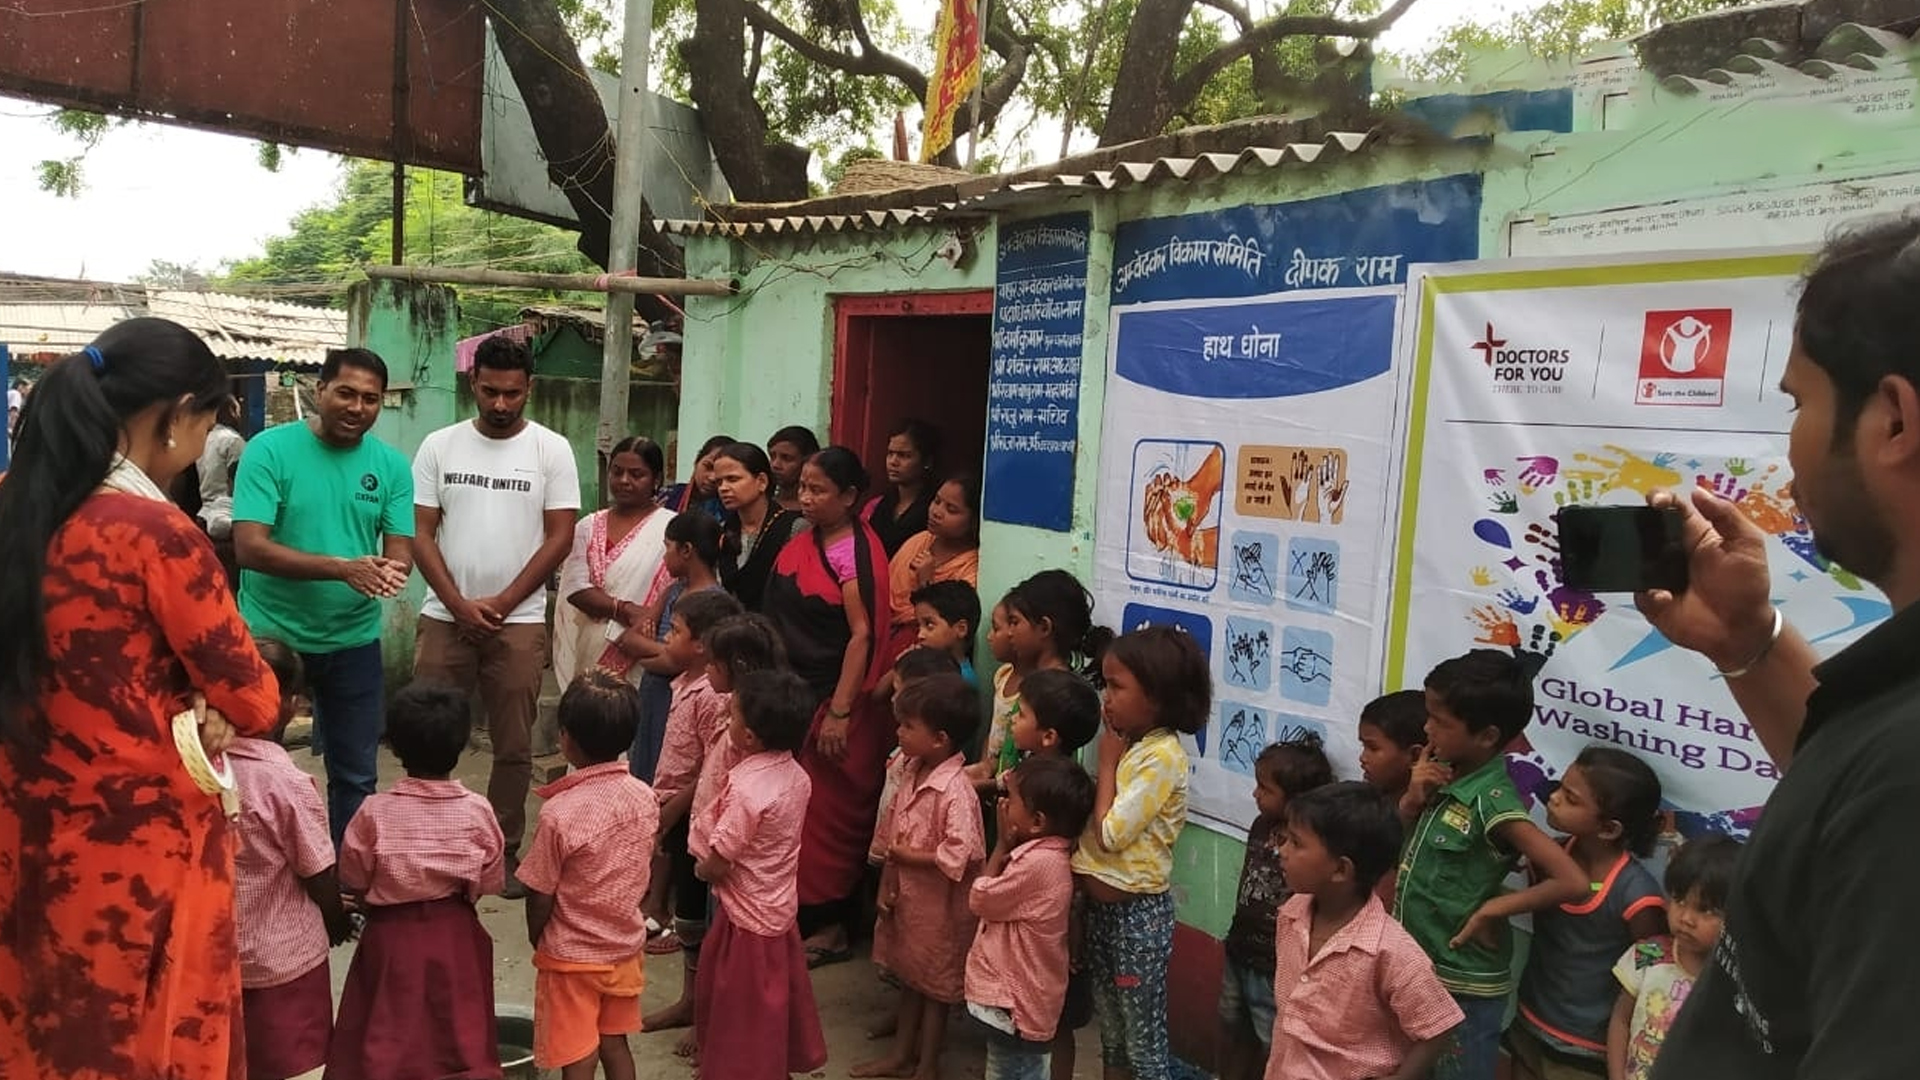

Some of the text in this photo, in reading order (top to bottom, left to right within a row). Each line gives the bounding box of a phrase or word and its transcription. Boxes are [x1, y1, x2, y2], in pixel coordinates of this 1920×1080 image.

[1169, 235, 1212, 268] विकास
[1211, 233, 1266, 280] समिति
[1285, 247, 1346, 288] दीपक
[1355, 253, 1404, 286] राम
[1203, 324, 1282, 361] हाथ धोना
[1496, 349, 1570, 364] DOCTORS
[1494, 367, 1564, 381] FOR YOU
[444, 473, 531, 492] WELFARE UNITED
[1541, 678, 1665, 722] Global
[1534, 704, 1706, 769] Washing
